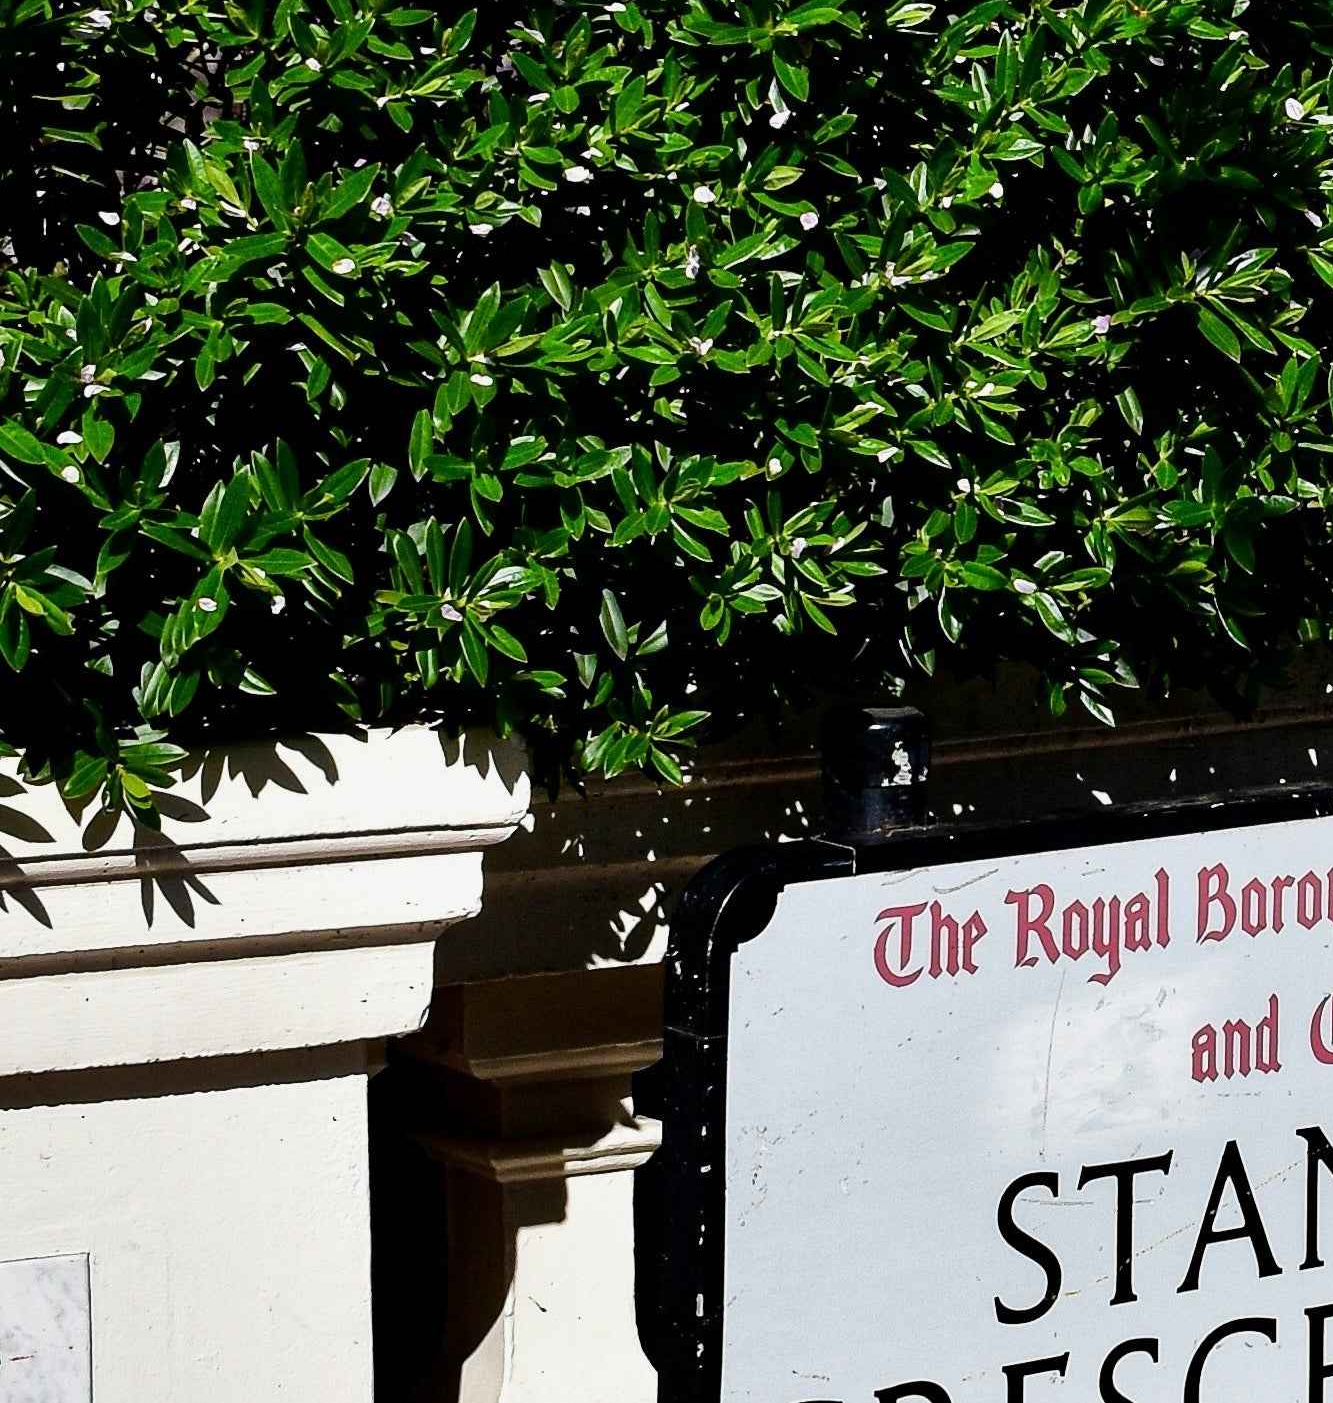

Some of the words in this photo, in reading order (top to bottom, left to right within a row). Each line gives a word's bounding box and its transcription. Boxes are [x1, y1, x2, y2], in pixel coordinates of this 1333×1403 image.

[874, 900, 988, 988] The
[1004, 866, 1170, 986] Royal
[1190, 992, 1282, 1084] and
